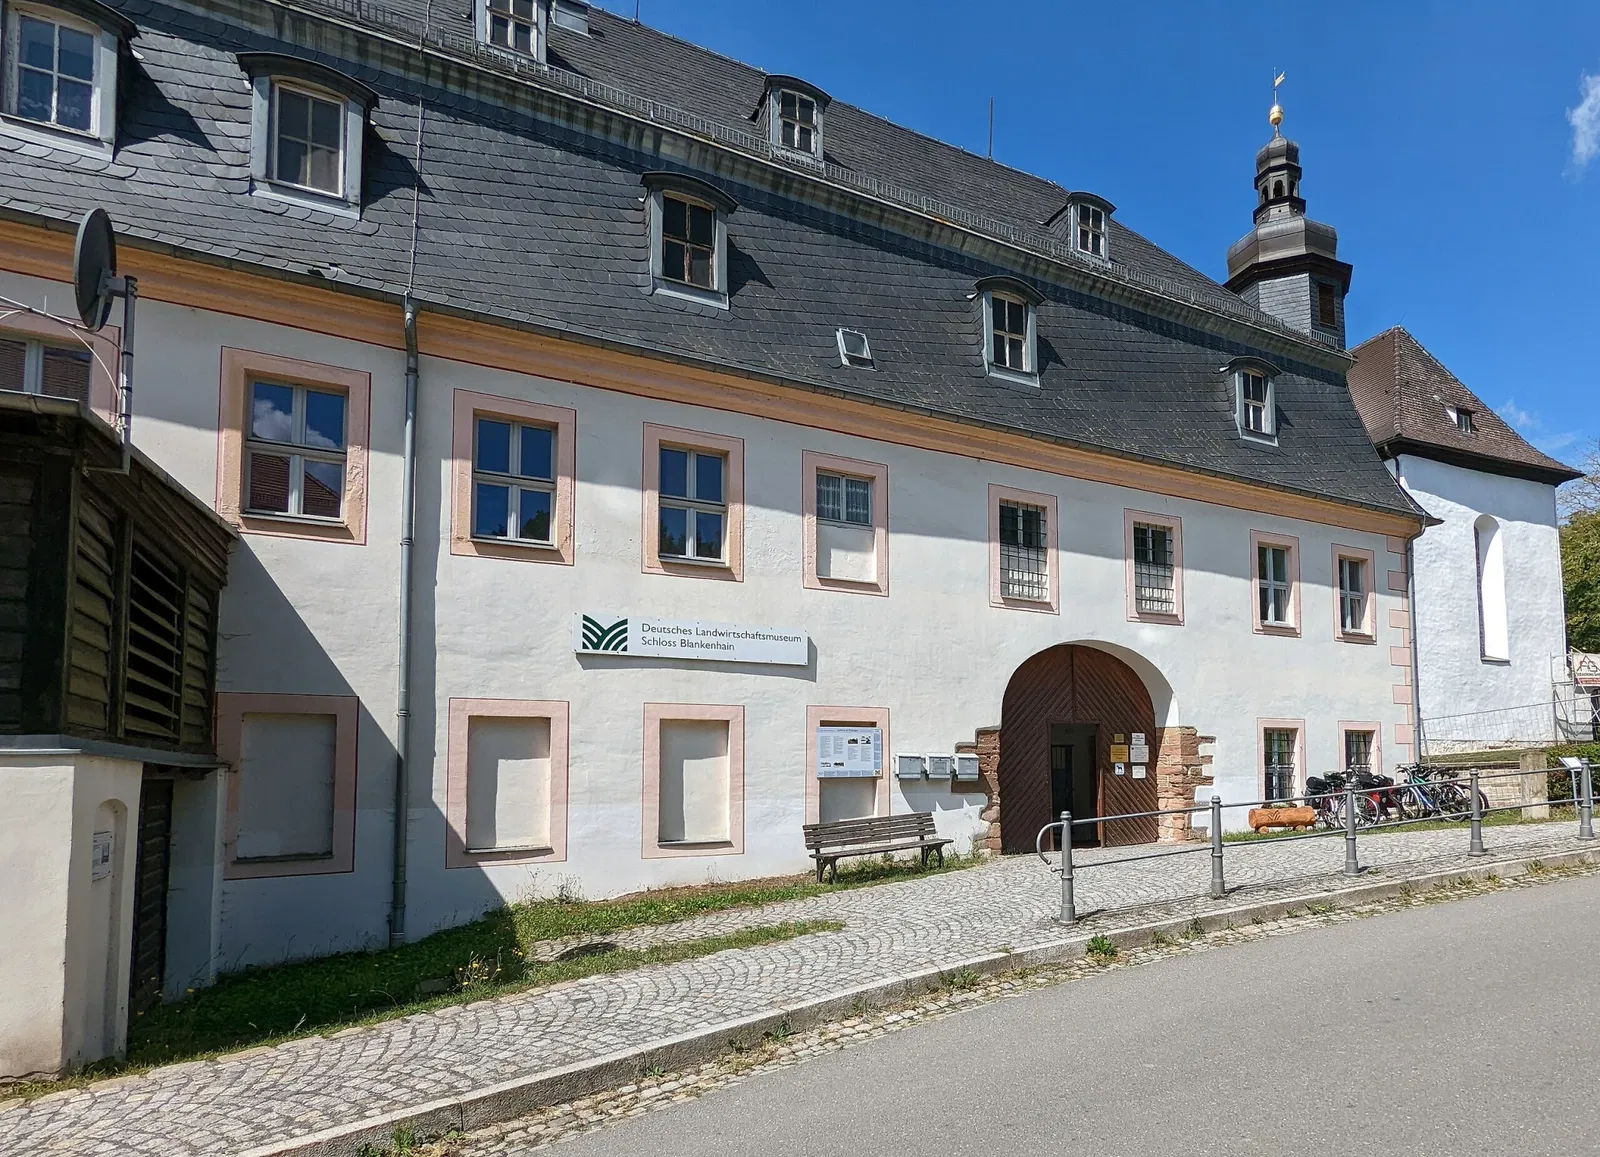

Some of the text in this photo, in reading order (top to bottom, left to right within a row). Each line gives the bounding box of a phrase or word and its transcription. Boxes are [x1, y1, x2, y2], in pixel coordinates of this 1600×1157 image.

[641, 623, 802, 643] Deutsches Landwirtschaftsmuseum
[641, 636, 735, 651] Schloss Blankenhain
